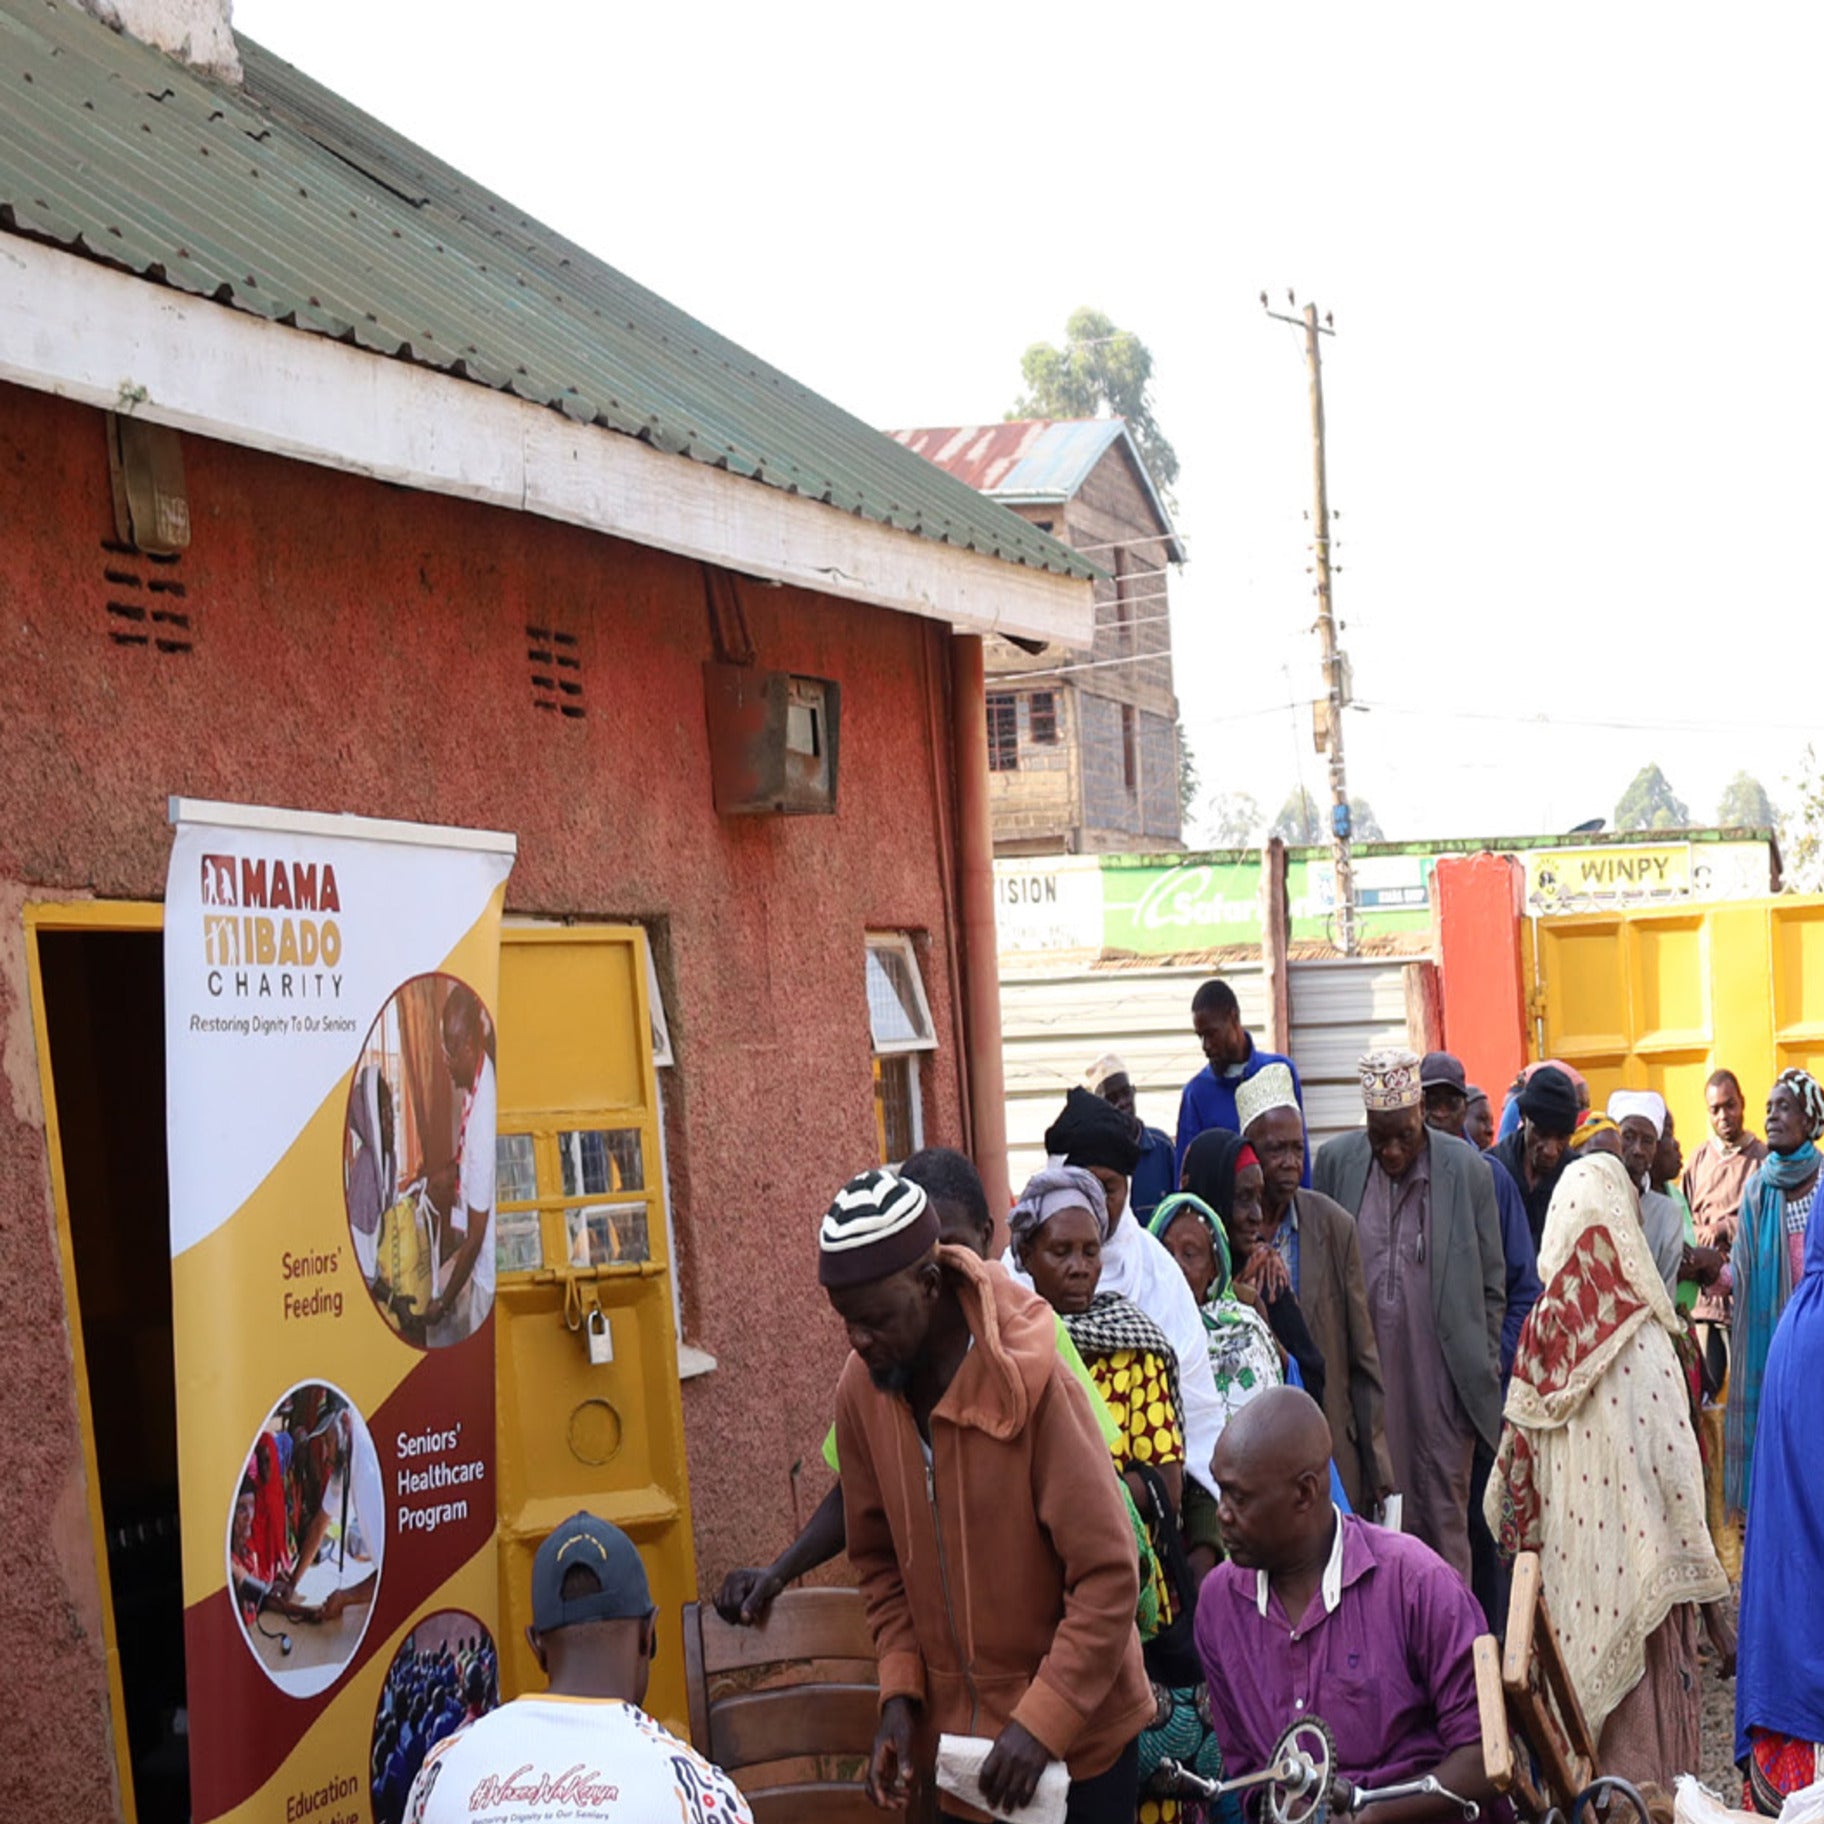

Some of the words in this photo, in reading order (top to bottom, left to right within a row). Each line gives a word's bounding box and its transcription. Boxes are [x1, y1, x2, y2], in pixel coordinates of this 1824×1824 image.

[241, 857, 341, 913] MAMA
[1580, 856, 1670, 882] WINPY
[243, 916, 342, 969] IBADO
[207, 970, 343, 998] CHARITY
[190, 1014, 250, 1036] Restoring
[252, 1015, 290, 1036] Dignity
[291, 1016, 302, 1032] To
[304, 1016, 321, 1032] Our
[323, 1016, 357, 1033] Seniors
[282, 1246, 342, 1280] Seniors'
[284, 1290, 344, 1320] Feeding
[396, 1423, 462, 1459] Seniors'
[397, 1460, 485, 1496] Healthcare
[398, 1499, 468, 1534] Program
[286, 1775, 359, 1824] Education
